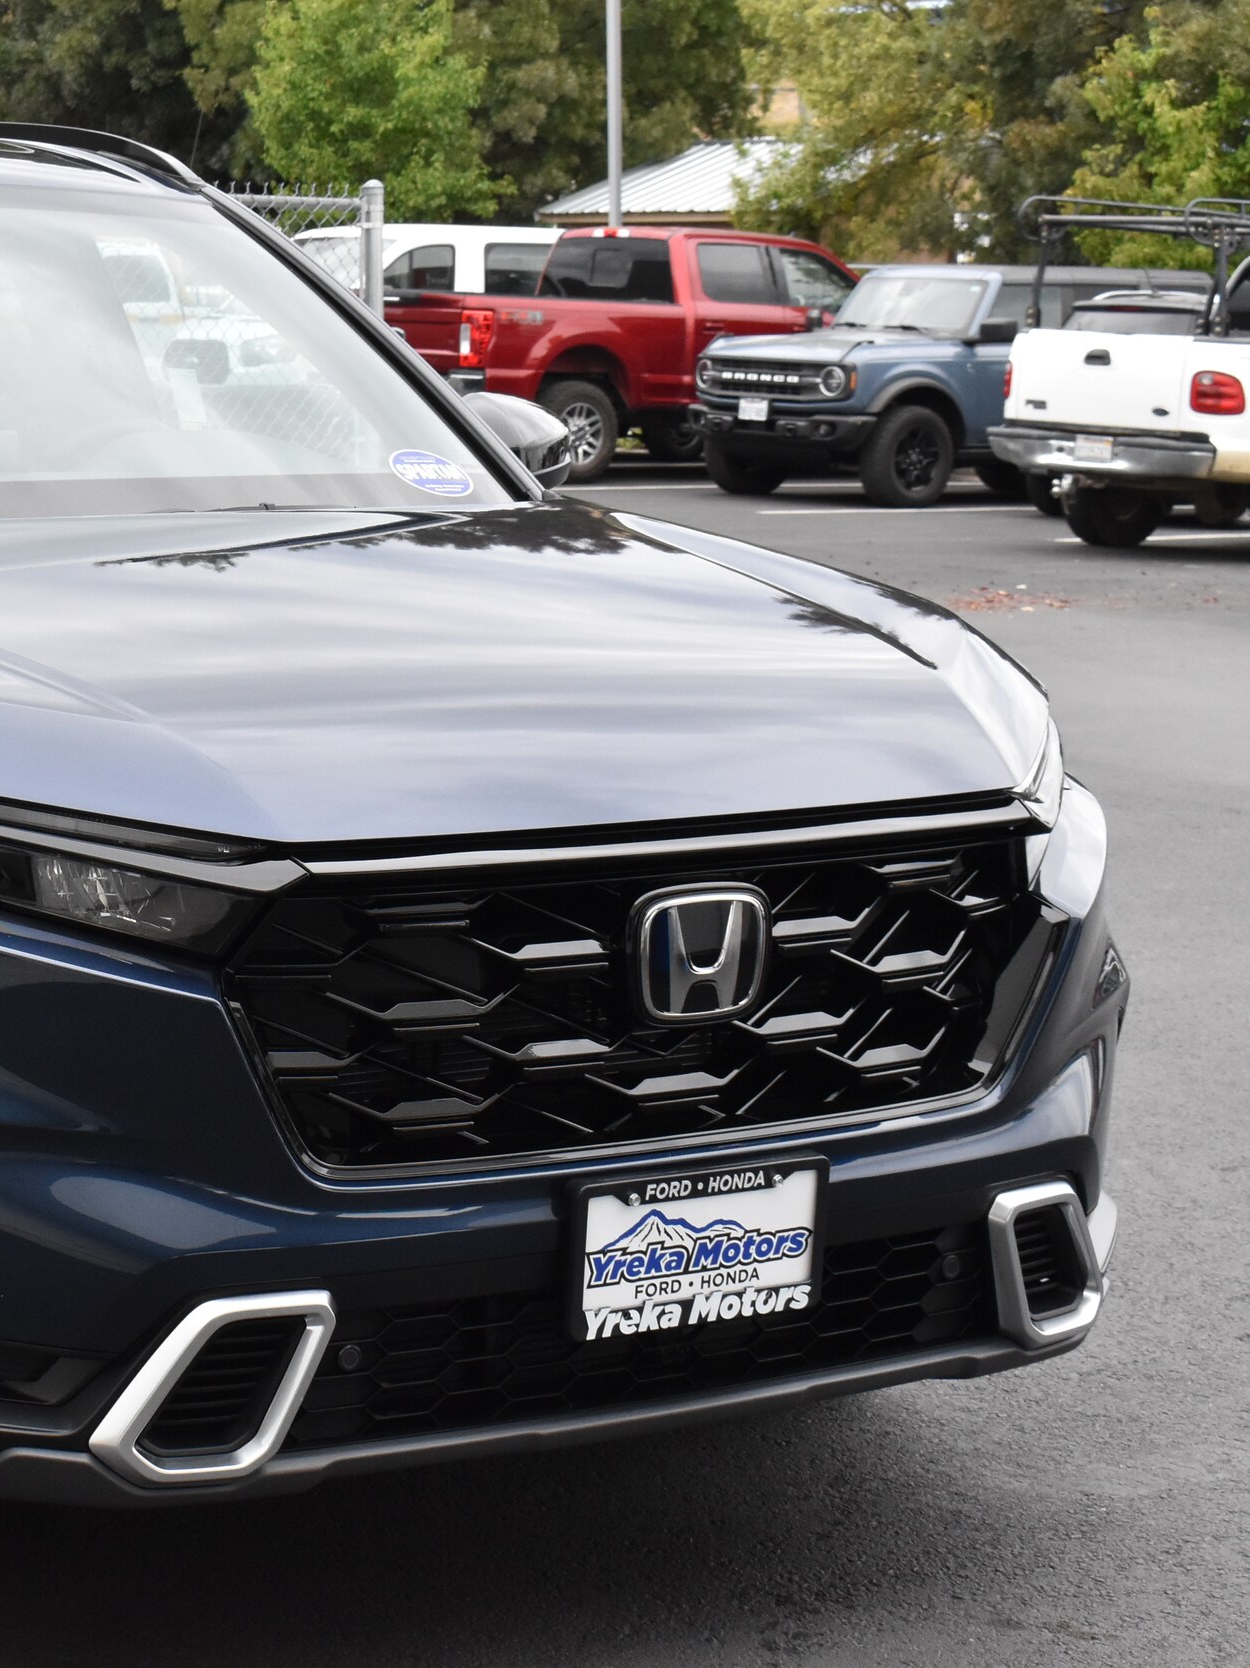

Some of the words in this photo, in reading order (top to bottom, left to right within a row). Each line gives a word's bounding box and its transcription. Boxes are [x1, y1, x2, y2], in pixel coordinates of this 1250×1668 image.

[645, 1180, 692, 1201] FORD
[707, 1171, 765, 1193] HONDA
[589, 1246, 688, 1283] Yreka
[692, 1231, 808, 1269] Motors
[634, 1279, 682, 1299] FORD
[700, 1267, 760, 1289] HONDA
[584, 1299, 682, 1341] Yreka
[688, 1284, 812, 1325] Motors
